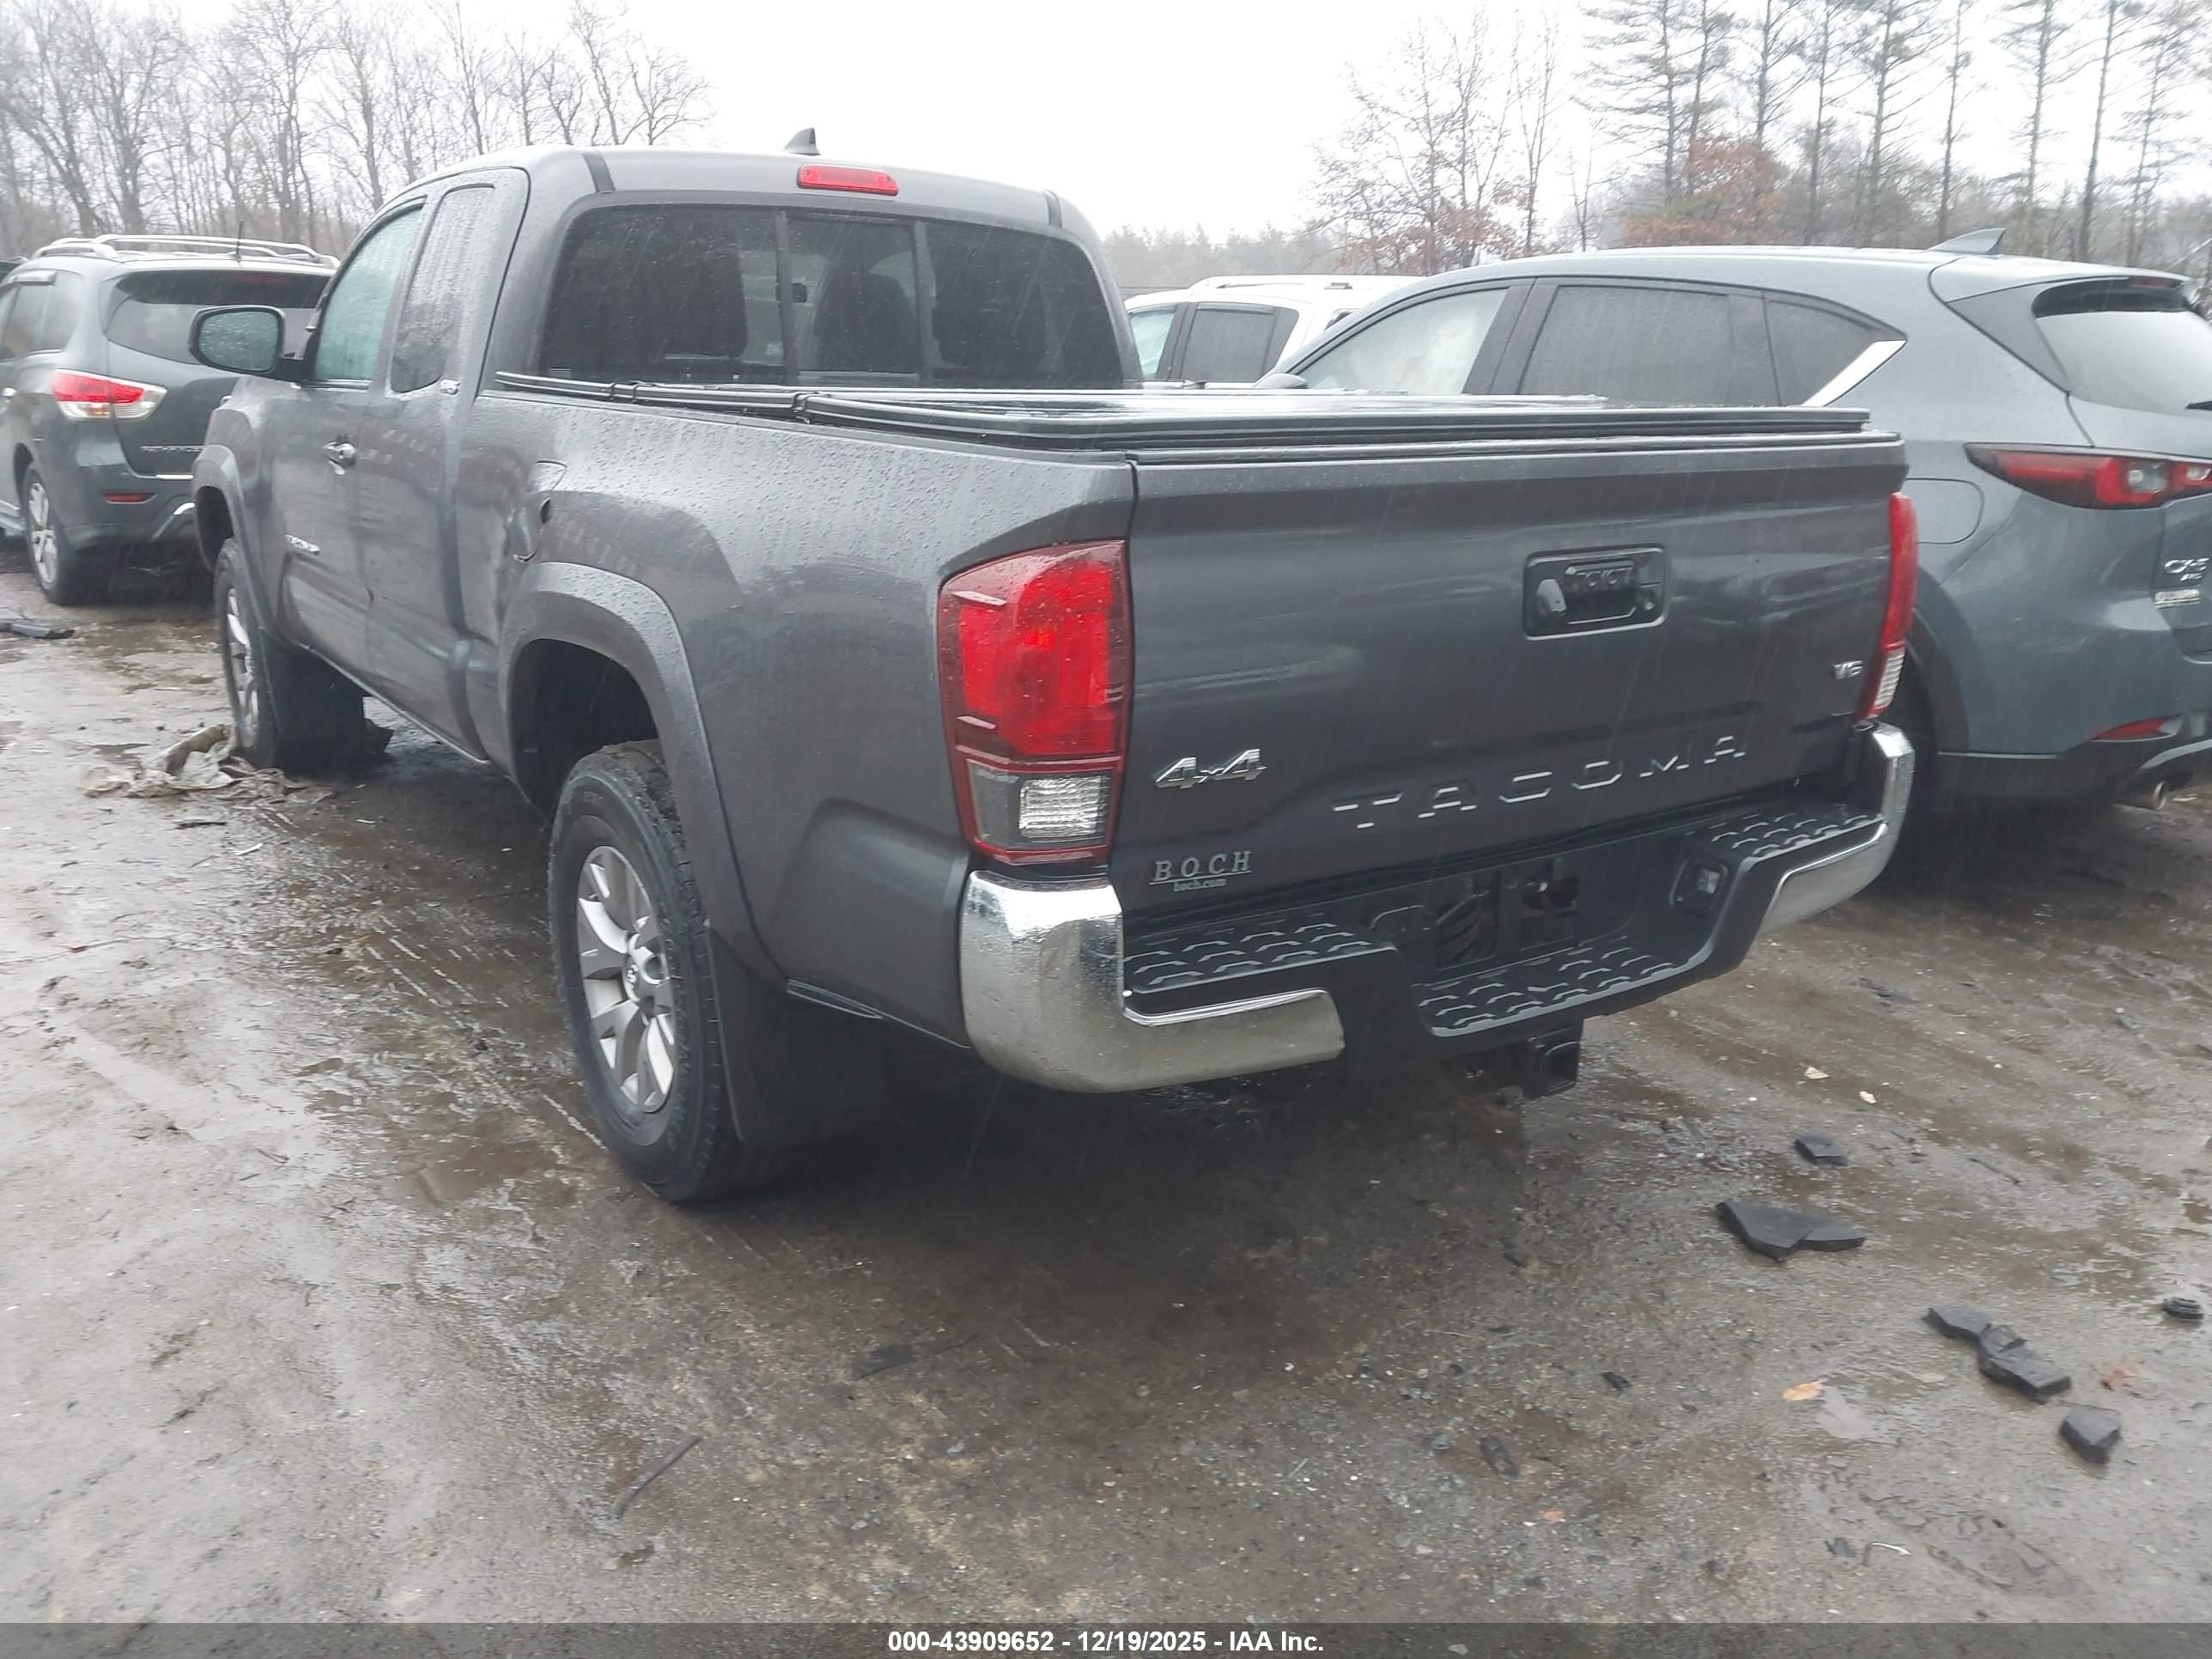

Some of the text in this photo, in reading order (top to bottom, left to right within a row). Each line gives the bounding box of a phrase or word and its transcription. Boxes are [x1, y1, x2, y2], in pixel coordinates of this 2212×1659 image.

[1833, 659, 1863, 679] V6
[1333, 735, 1747, 830] TACOMA
[1152, 850, 1252, 882] BOCH
